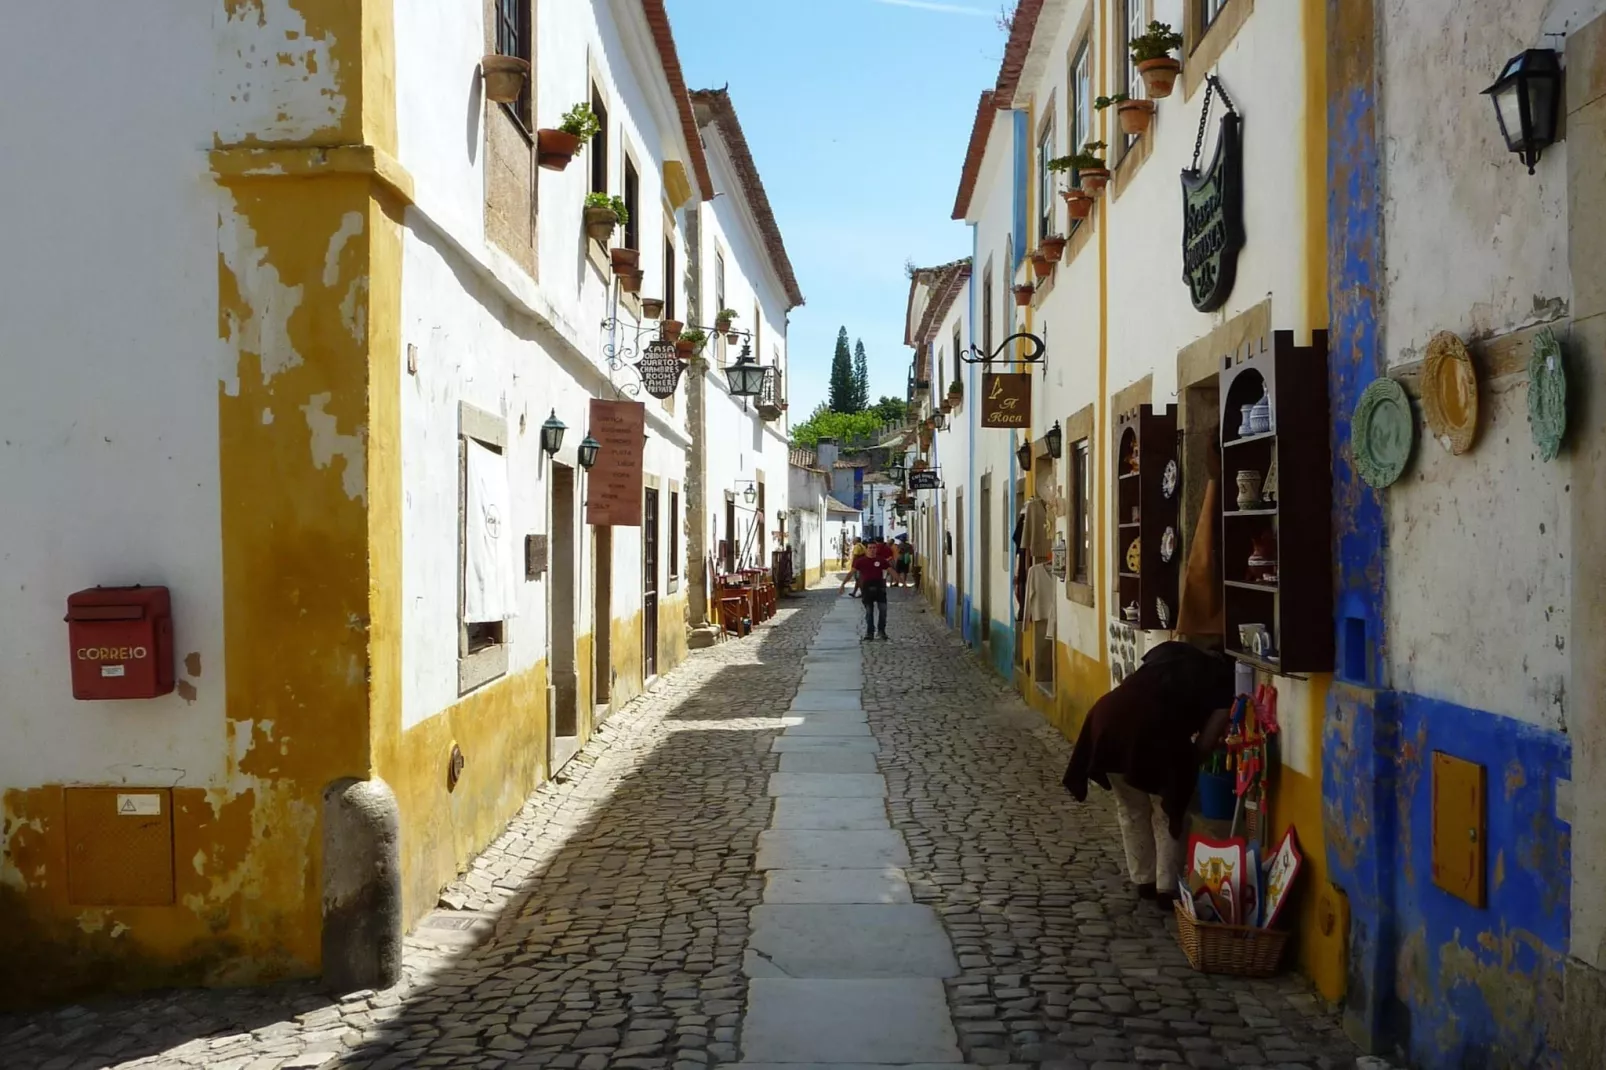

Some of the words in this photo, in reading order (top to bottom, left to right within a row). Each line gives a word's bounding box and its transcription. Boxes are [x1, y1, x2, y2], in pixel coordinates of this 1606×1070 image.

[649, 345, 675, 353] CASA
[646, 372, 676, 380] ROOMS
[644, 379, 677, 387] CAMERE
[987, 411, 1023, 423] Roca
[77, 646, 147, 660] CORREIO
